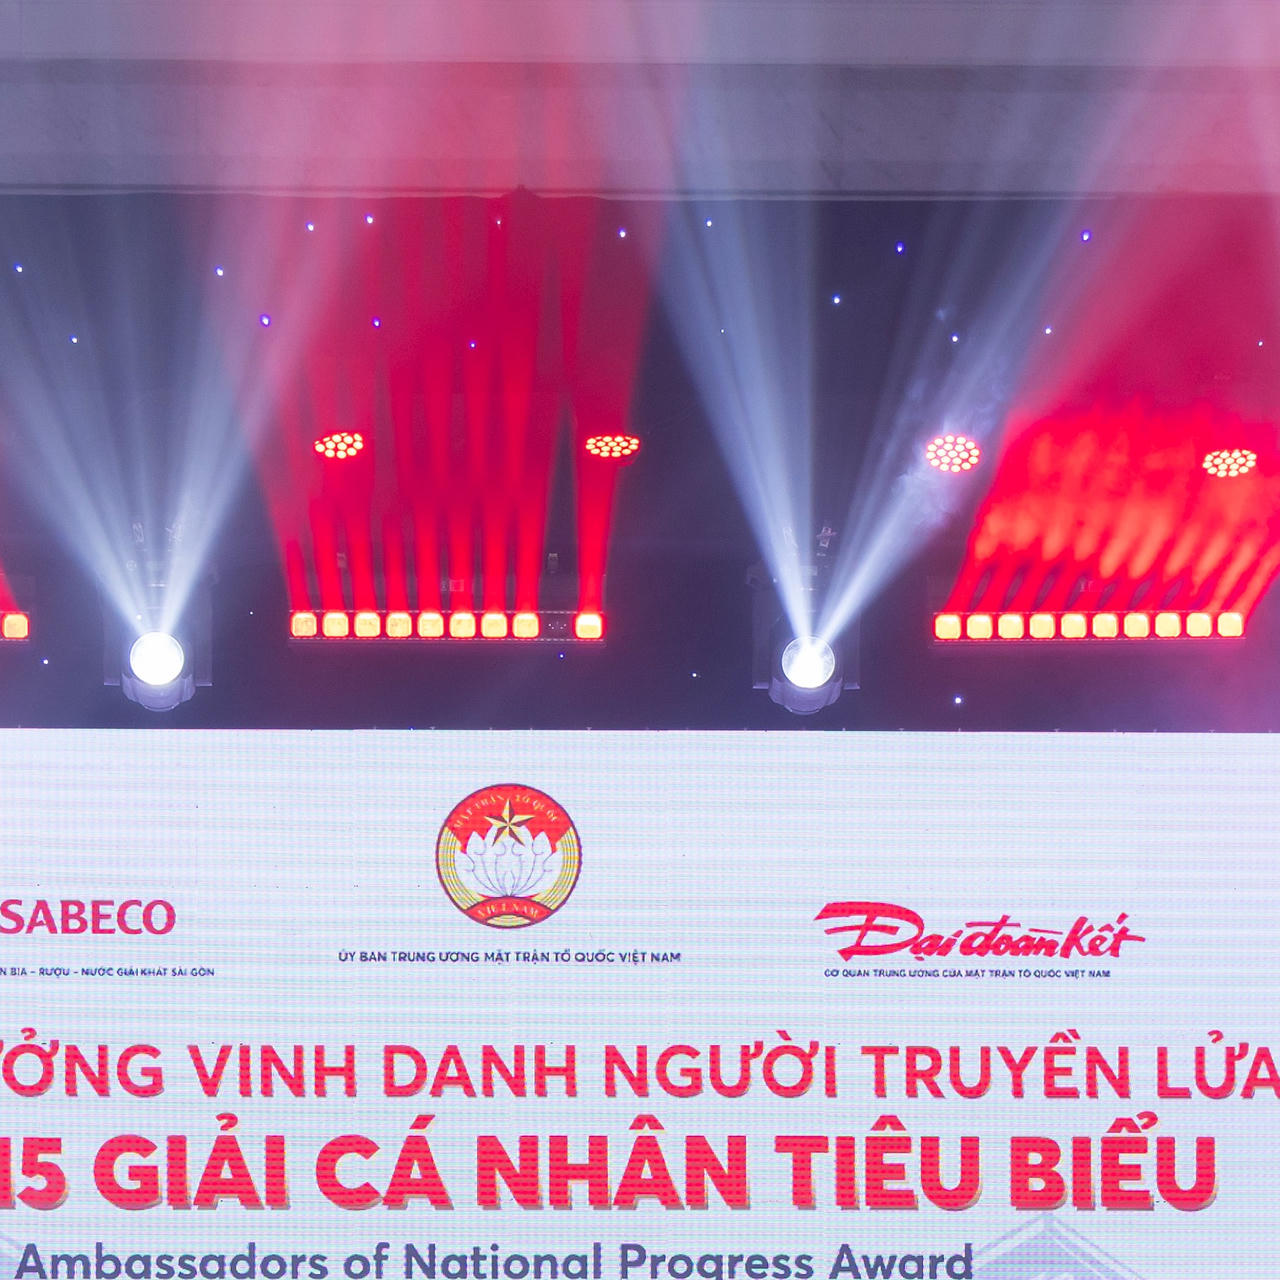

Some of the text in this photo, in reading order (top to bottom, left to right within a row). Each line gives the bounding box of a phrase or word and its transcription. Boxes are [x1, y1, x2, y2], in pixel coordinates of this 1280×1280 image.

[0, 899, 177, 935] SABECO
[10, 966, 28, 976] BIA
[359, 951, 388, 963] BAN
[390, 951, 436, 963] TRUNG
[438, 950, 481, 963] ƯƠNG
[484, 949, 511, 965] MẶT
[515, 948, 550, 965] TRẬN
[553, 948, 571, 963] TỔ
[574, 948, 615, 963] QUỐC
[618, 948, 648, 966] VIỆT
[650, 951, 682, 963] NAM
[842, 968, 870, 978] QUAN
[873, 968, 907, 978] TRUNG
[1088, 969, 1111, 978] NAM
[188, 1044, 357, 1098] VINH
[383, 1044, 578, 1098] DANH
[604, 1029, 838, 1098] NGƯỜI
[861, 1029, 1131, 1098] TRUYỀN
[93, 1113, 289, 1209] GIẢI
[316, 1115, 453, 1209] CÁ
[476, 1114, 749, 1208] NHÂN
[775, 1114, 982, 1210] TIÊU
[1010, 1110, 1218, 1210] BIỂU
[13, 1241, 329, 1280] Ambassadors
[343, 1241, 391, 1280] of
[403, 1242, 602, 1280] National
[828, 1242, 974, 1280] Award
